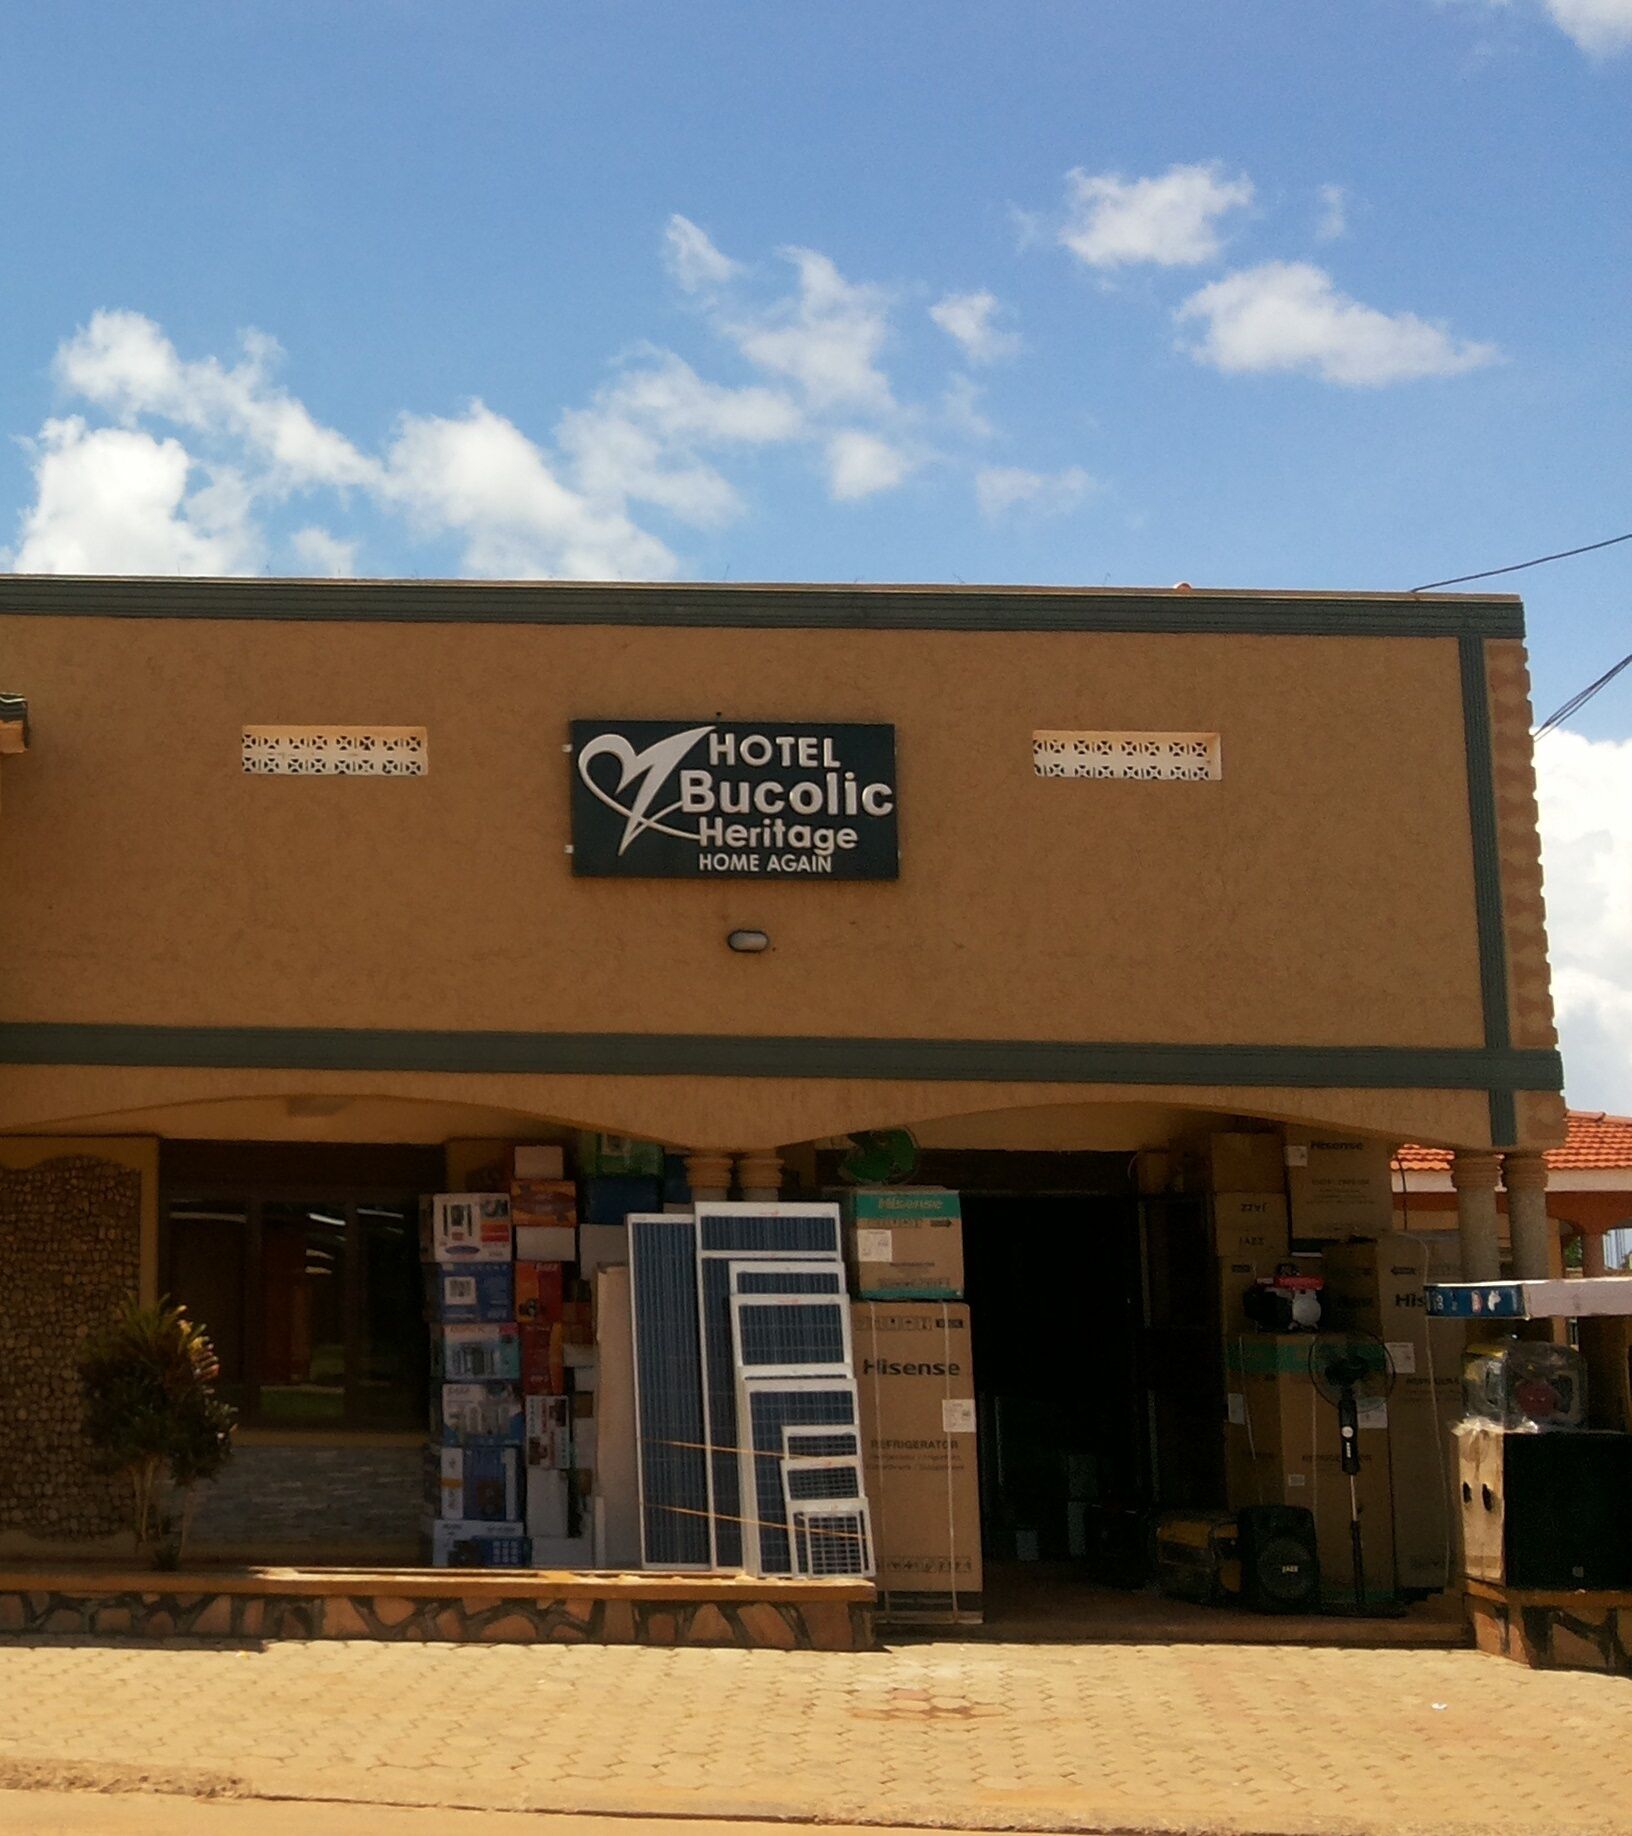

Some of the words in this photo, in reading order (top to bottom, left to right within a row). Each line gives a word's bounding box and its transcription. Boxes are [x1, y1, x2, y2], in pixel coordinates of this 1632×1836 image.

[709, 732, 841, 768] HOTEL
[680, 769, 894, 817] Bucolic
[698, 816, 859, 856] Heritage
[699, 854, 760, 872] HOME
[766, 854, 832, 873] AGAIN
[863, 1358, 961, 1376] Hisense
